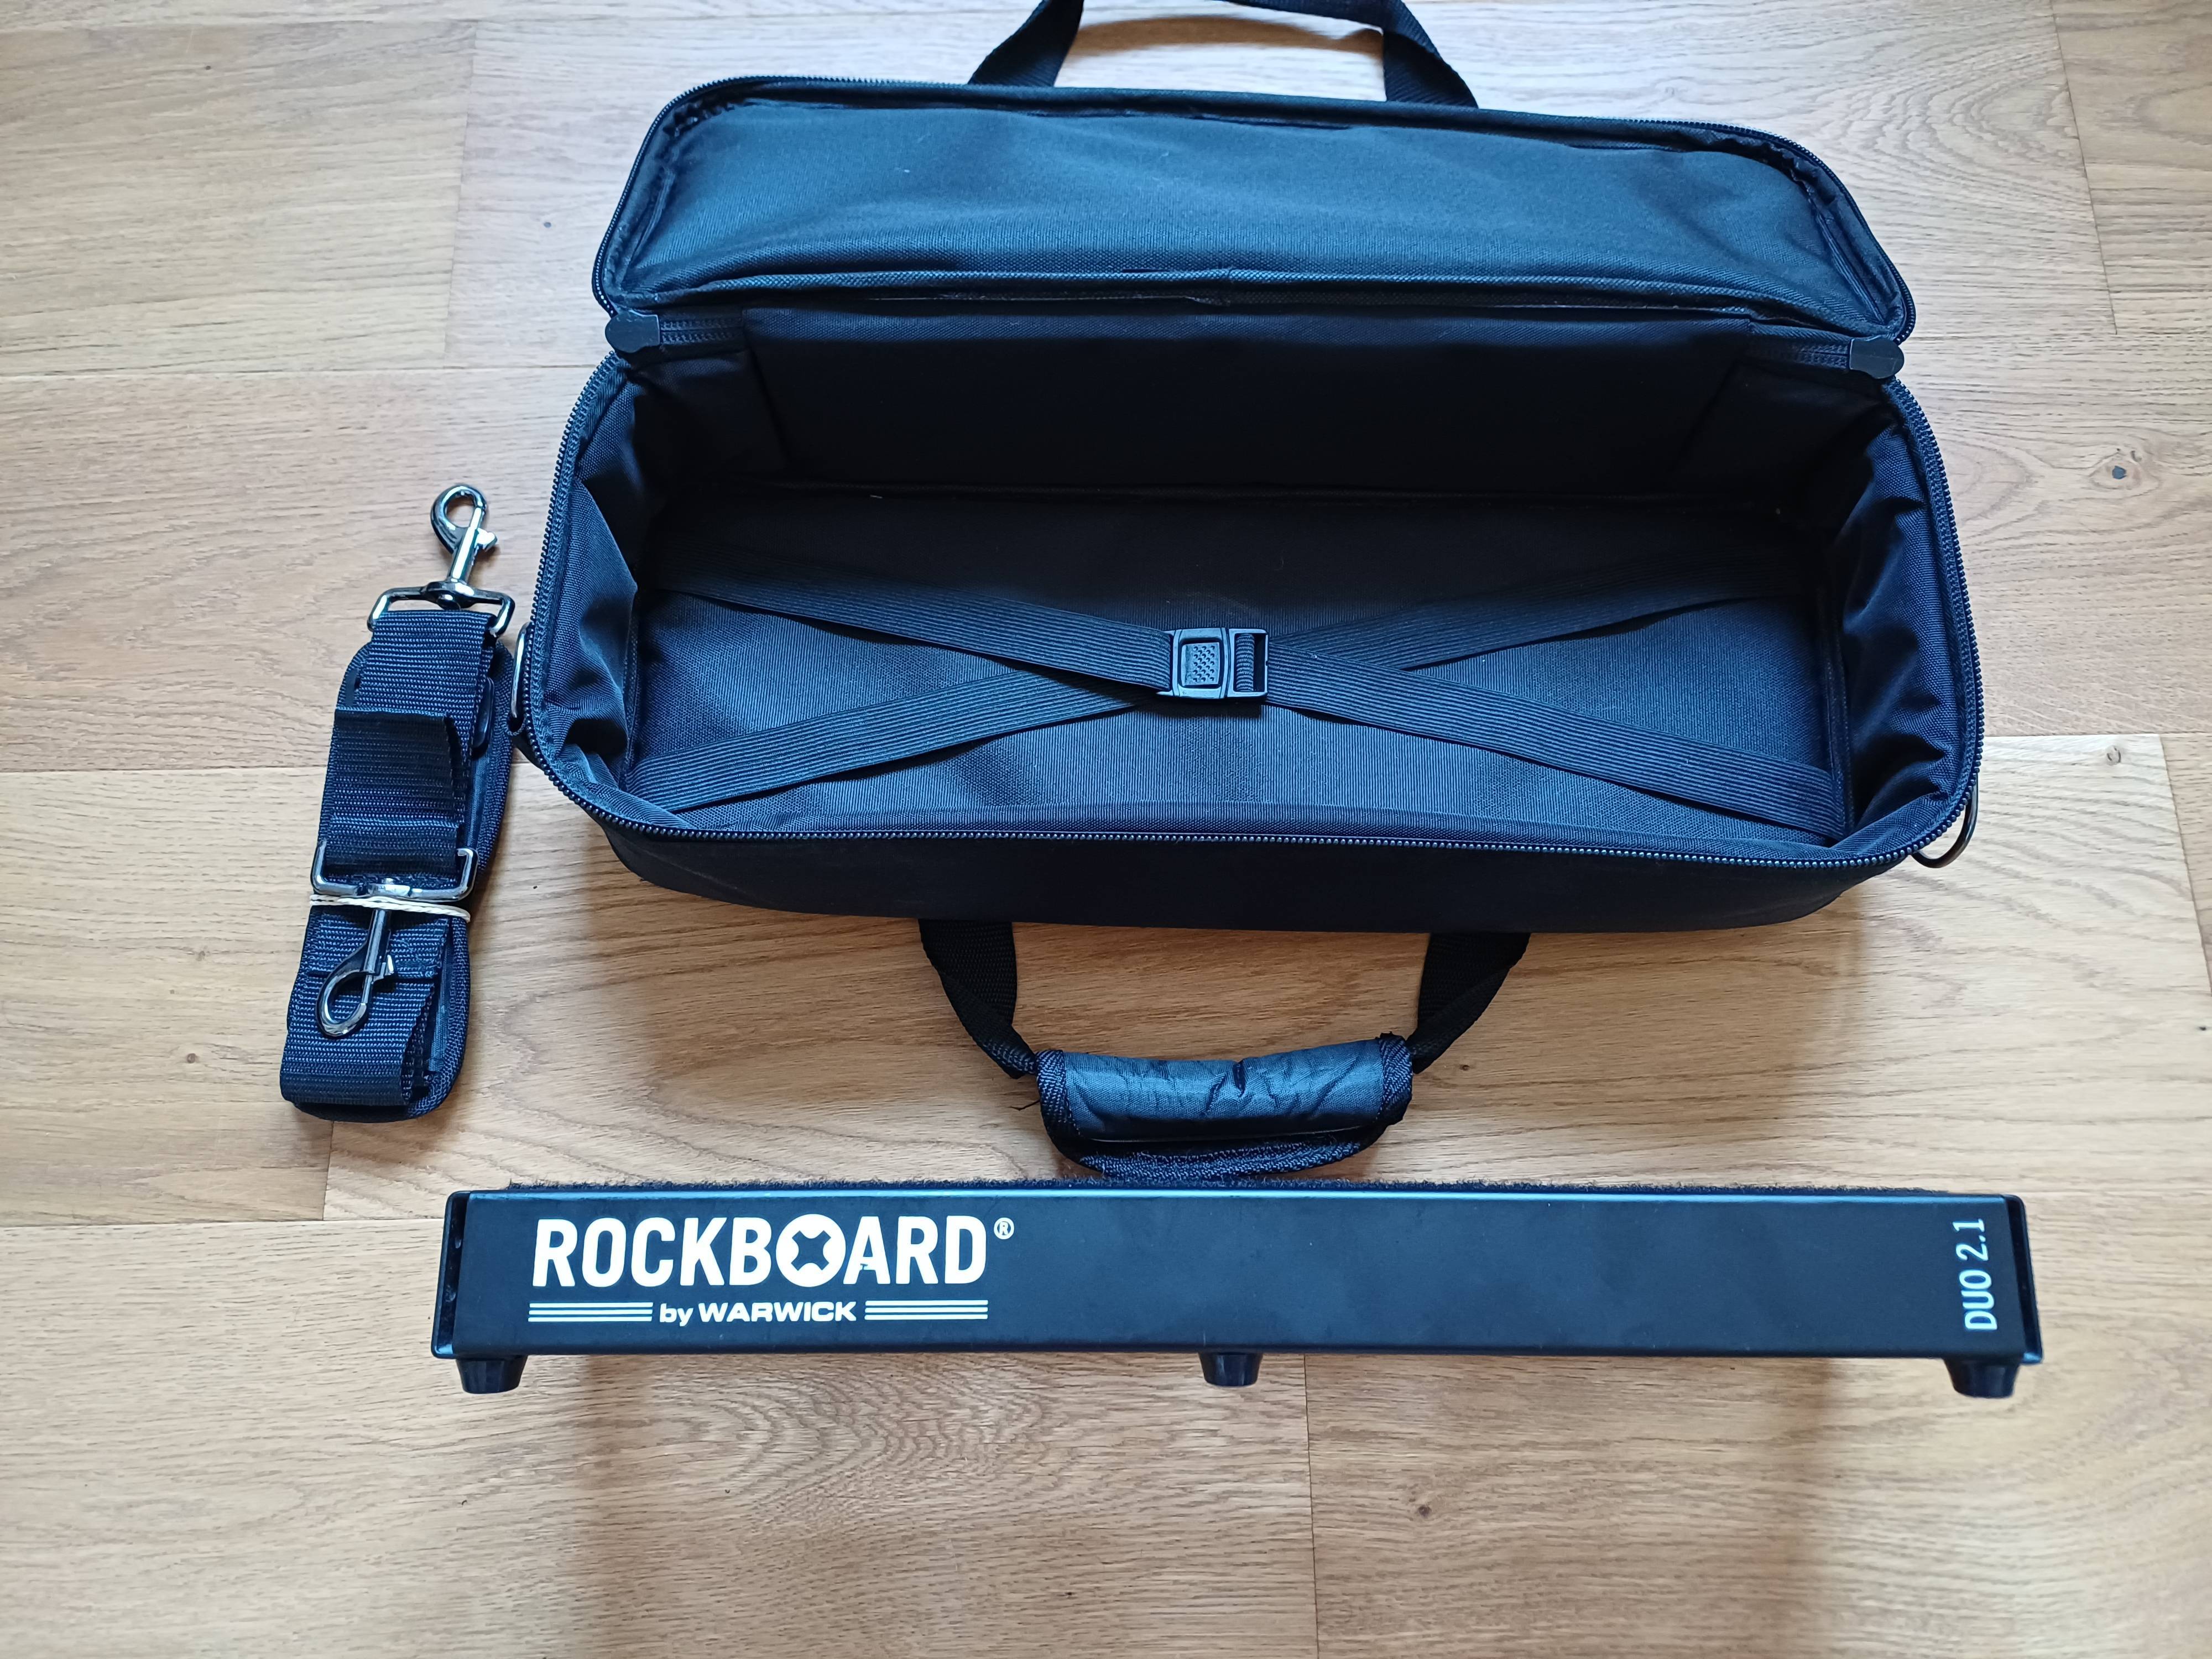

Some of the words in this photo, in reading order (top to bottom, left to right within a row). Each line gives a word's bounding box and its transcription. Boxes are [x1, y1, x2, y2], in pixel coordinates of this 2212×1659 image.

[1952, 1218, 1989, 1261] 2.1
[659, 1303, 692, 1327] by
[697, 1301, 857, 1323] WARWICK
[1959, 1269, 1998, 1331] DUO
